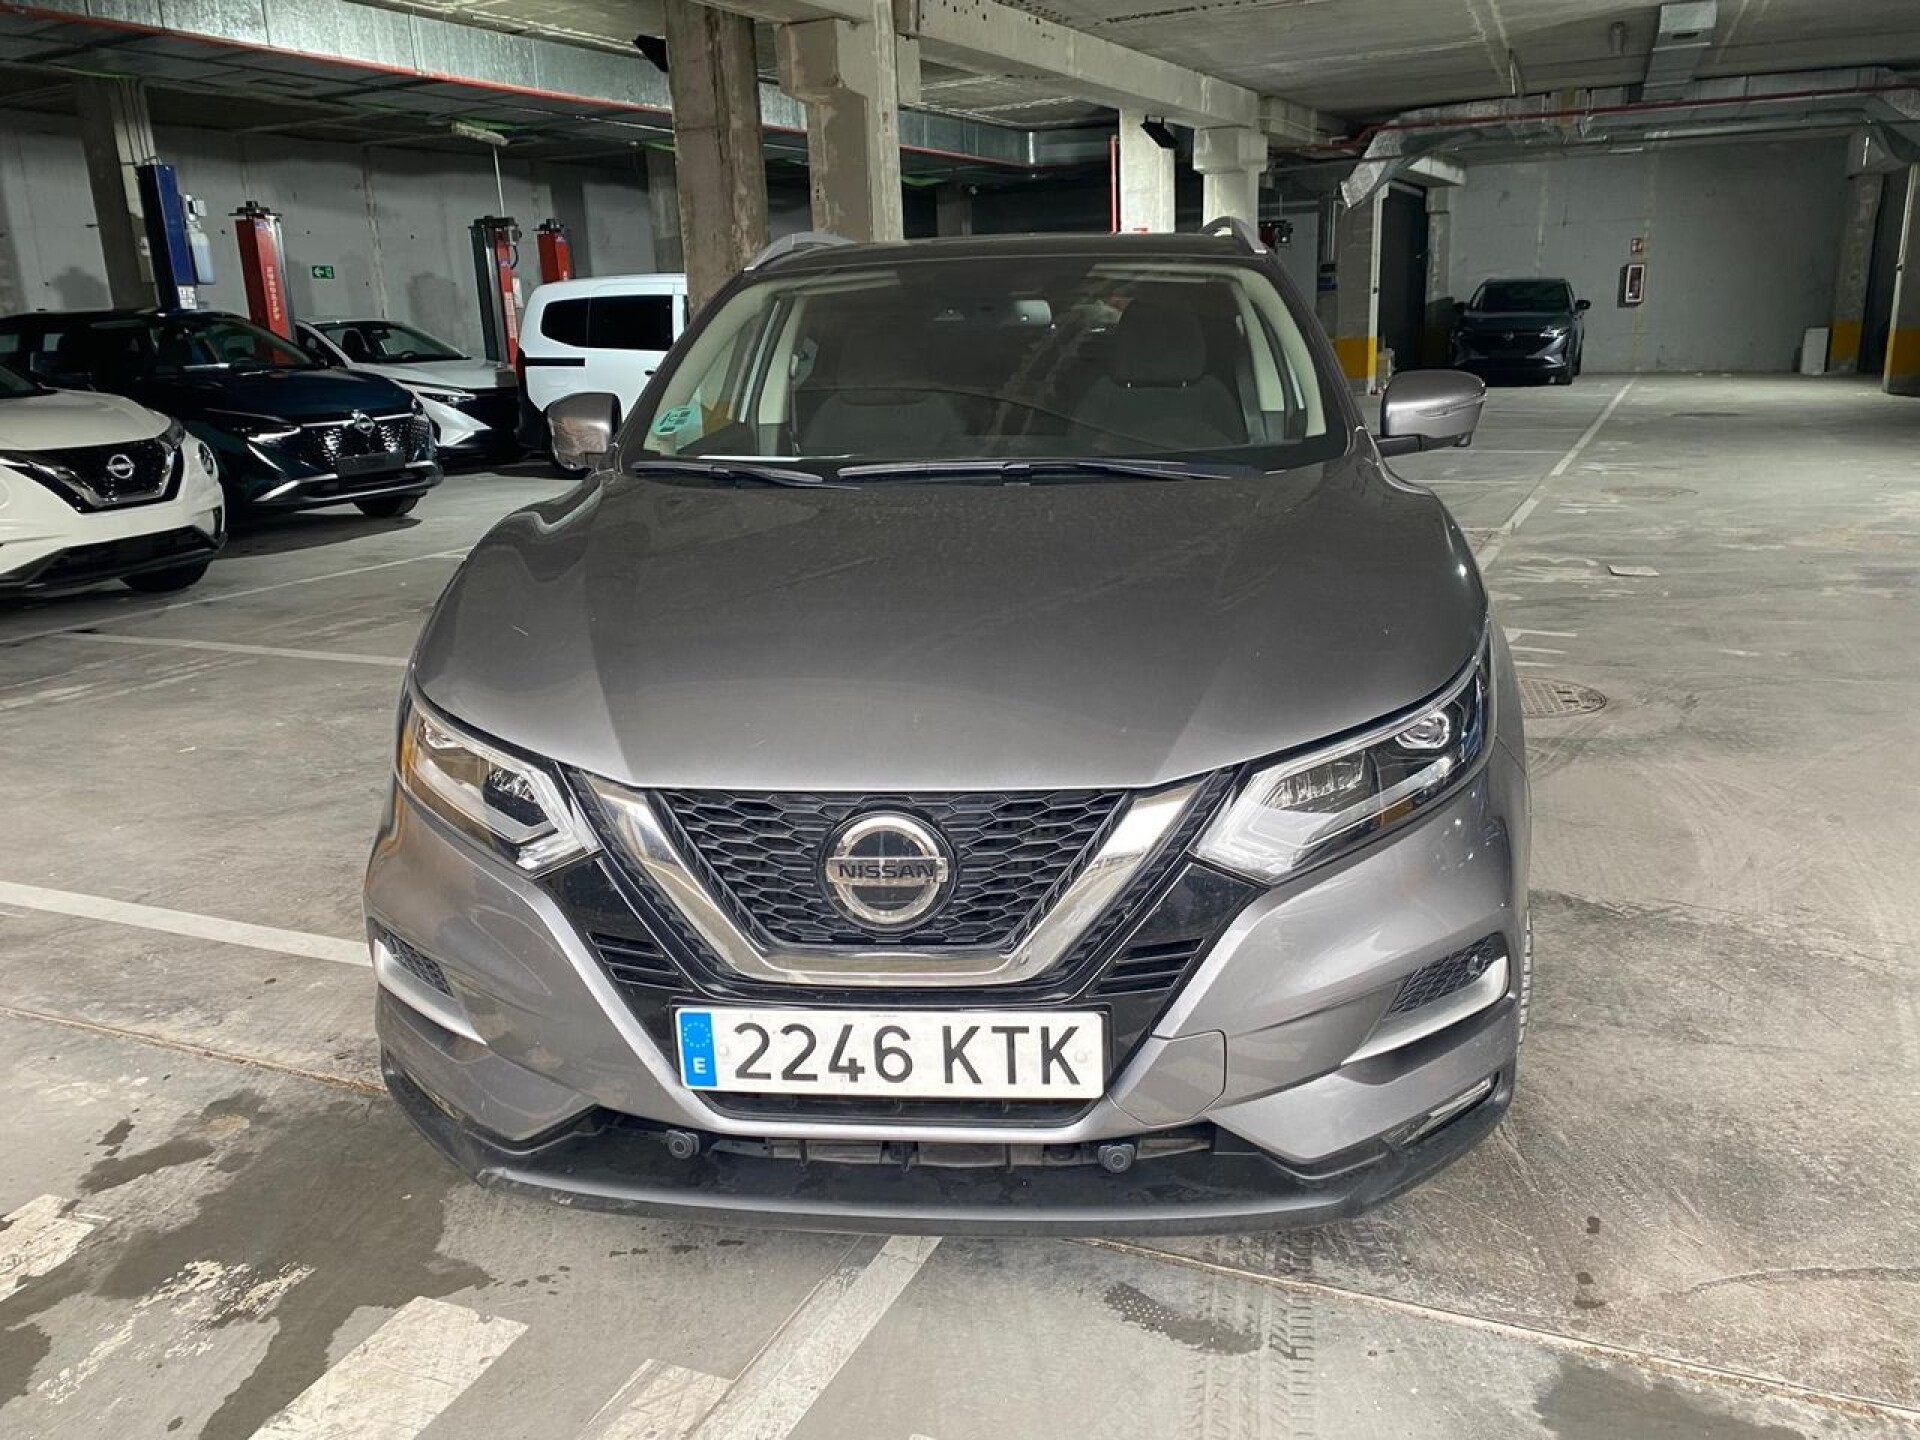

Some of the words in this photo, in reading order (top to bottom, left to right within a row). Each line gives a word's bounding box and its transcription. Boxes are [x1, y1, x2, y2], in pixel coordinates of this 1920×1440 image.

[838, 863, 935, 879] NISSAN
[733, 1022, 913, 1084] 2246
[942, 1025, 1081, 1085] KTK
[692, 1057, 708, 1074] E
